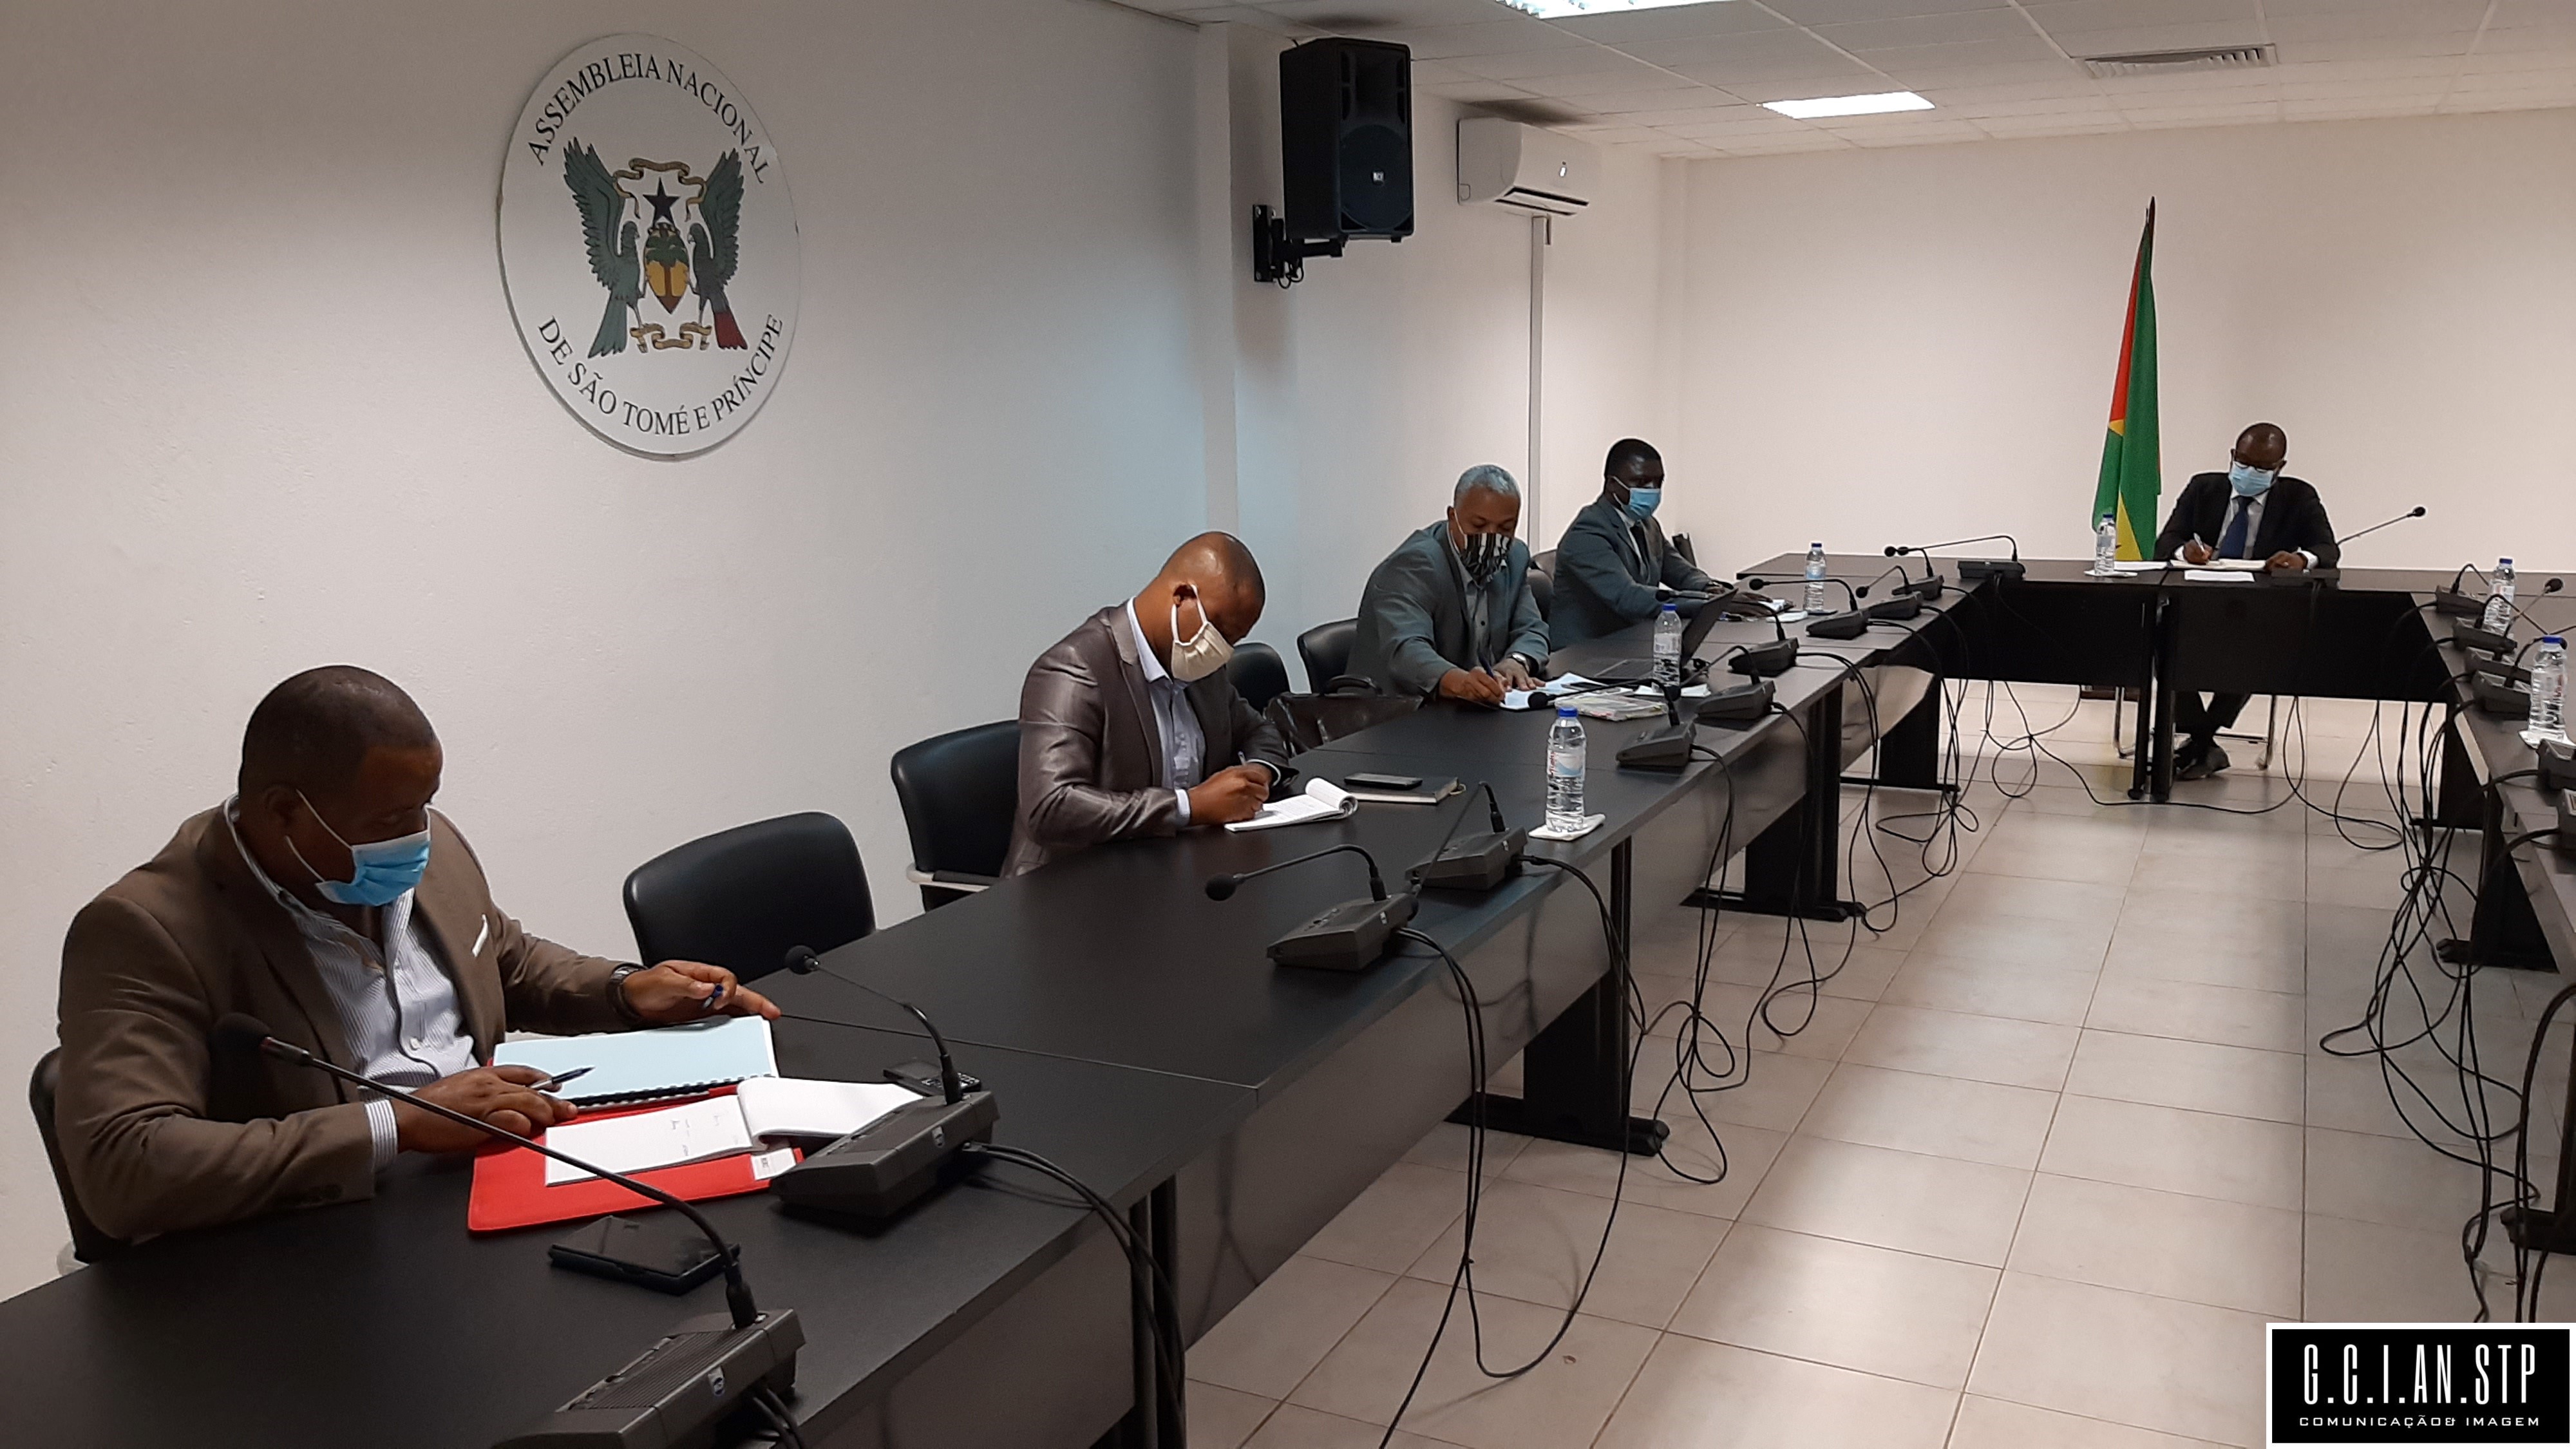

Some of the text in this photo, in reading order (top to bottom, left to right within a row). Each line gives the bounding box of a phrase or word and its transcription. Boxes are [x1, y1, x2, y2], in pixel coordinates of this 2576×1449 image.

[528, 53, 770, 184] ASSEMBLEIA NACIONAL
[538, 314, 783, 436] DE SÃO TOMÉ E PRÍNCIPE
